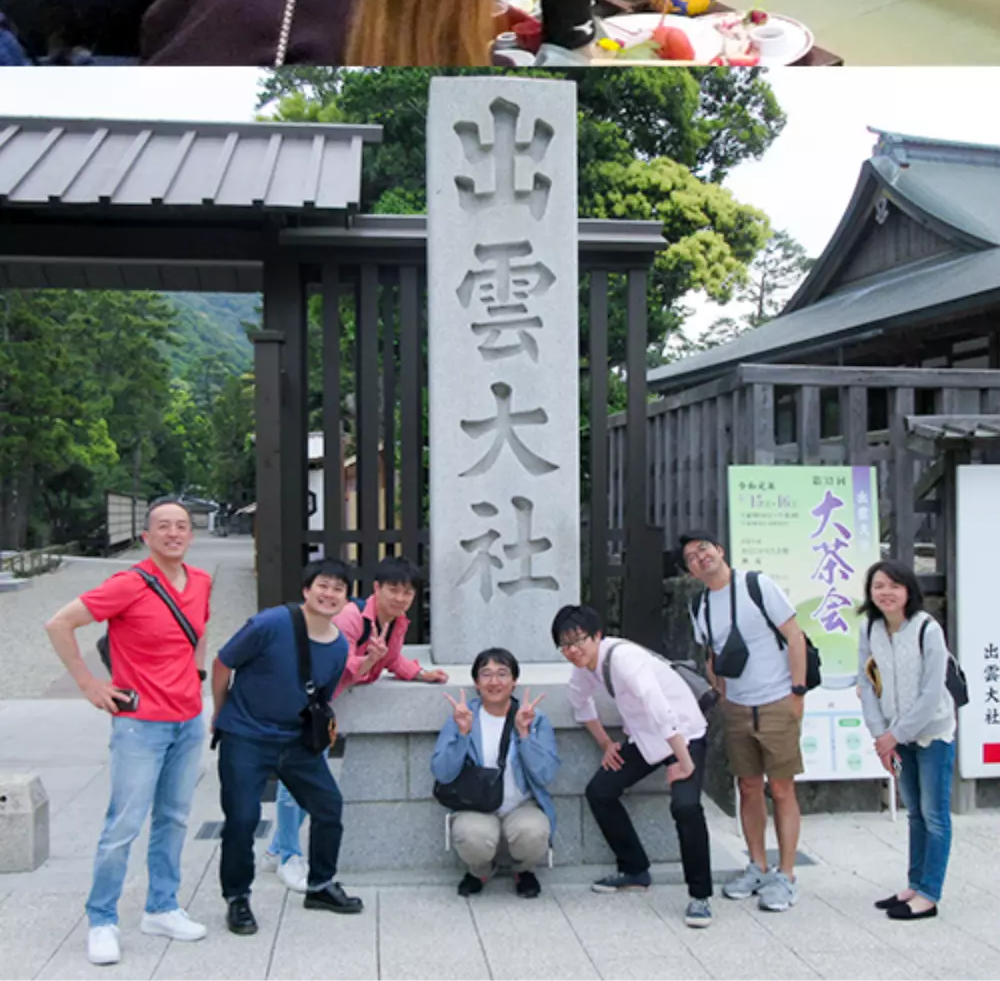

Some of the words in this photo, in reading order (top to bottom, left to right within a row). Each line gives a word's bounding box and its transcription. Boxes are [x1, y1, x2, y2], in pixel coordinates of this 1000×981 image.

[453, 96, 560, 603] 出雲大社
[810, 489, 855, 632] 大茶会
[983, 642, 1000, 725] 出雲大社
